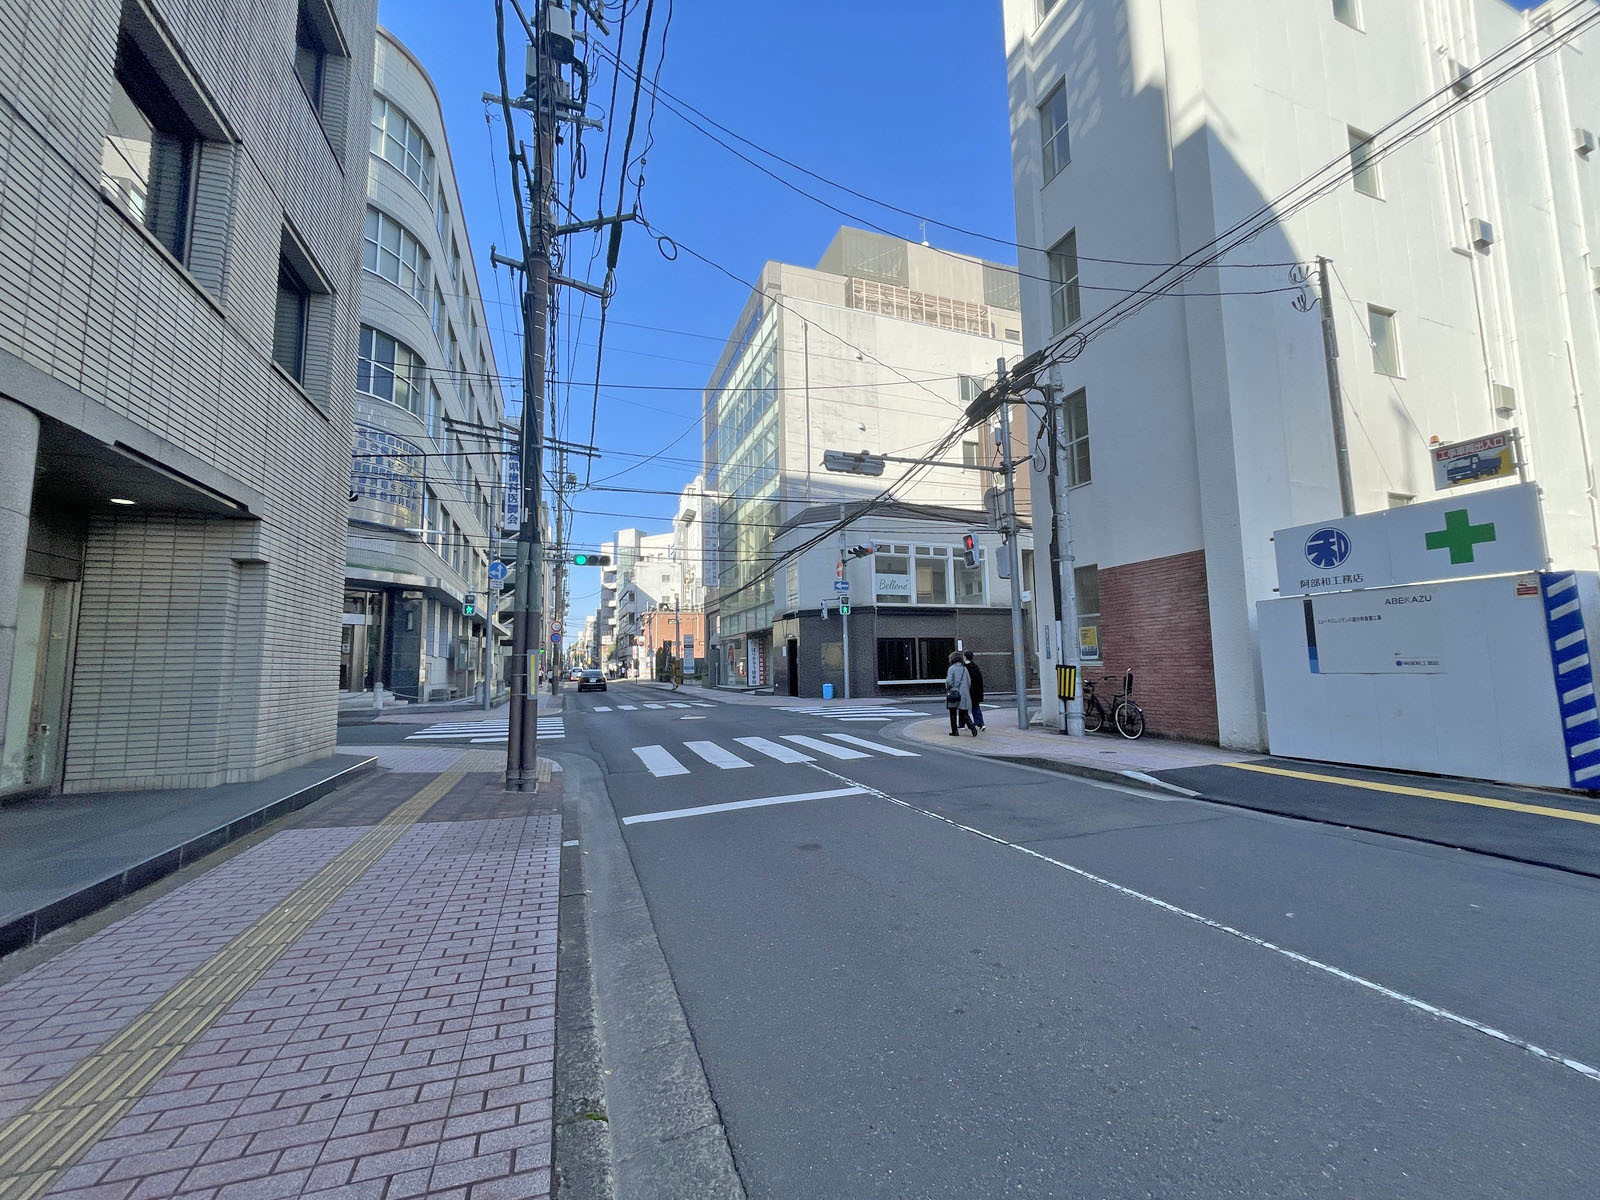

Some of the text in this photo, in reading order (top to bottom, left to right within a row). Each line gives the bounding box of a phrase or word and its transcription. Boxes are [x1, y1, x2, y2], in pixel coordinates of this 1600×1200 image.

[1299, 574, 1364, 588] 阿部和工務店
[1384, 595, 1432, 605] ABEKAZU
